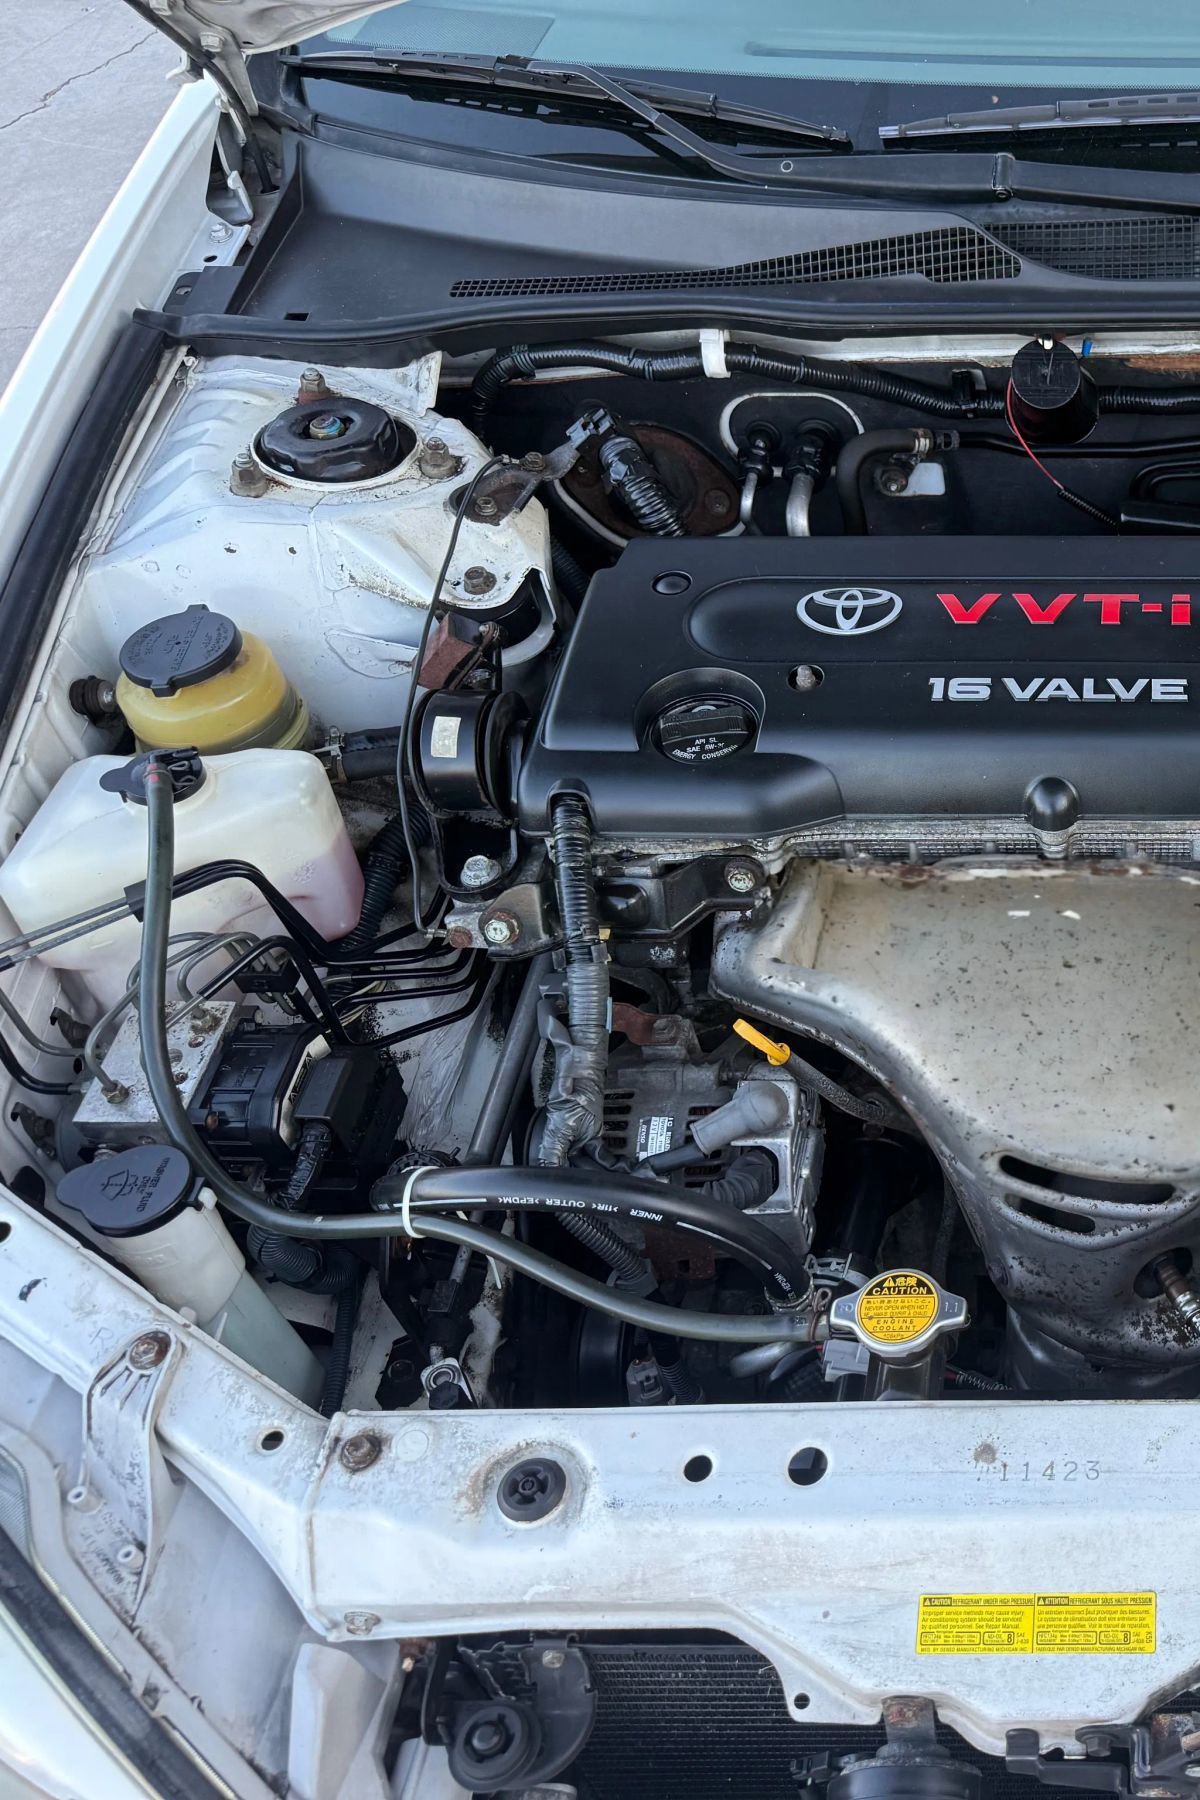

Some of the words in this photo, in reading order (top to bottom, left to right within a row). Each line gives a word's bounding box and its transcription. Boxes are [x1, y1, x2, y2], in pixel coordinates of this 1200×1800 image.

[936, 592, 1192, 626] VVT-i
[929, 677, 993, 701] 16
[1002, 677, 1190, 702] VALVE
[694, 738, 706, 746] API
[671, 748, 697, 760] ENERGY
[686, 745, 701, 753] SAE
[498, 1196, 540, 1205] >EPDM<
[545, 1198, 586, 1209] OUTER
[630, 1208, 664, 1222] INNER
[872, 1286, 928, 1296] CAUTION
[944, 1301, 958, 1313] 1.1
[998, 1460, 1101, 1482] 11423
[931, 1597, 952, 1606] CAUTION
[1045, 1597, 1069, 1605] ATTENTION
[1101, 1597, 1114, 1605] SOUS
[1114, 1597, 1129, 1605] HAUTE
[1006, 1633, 1013, 1644] 8
[1123, 1633, 1129, 1643] 8
